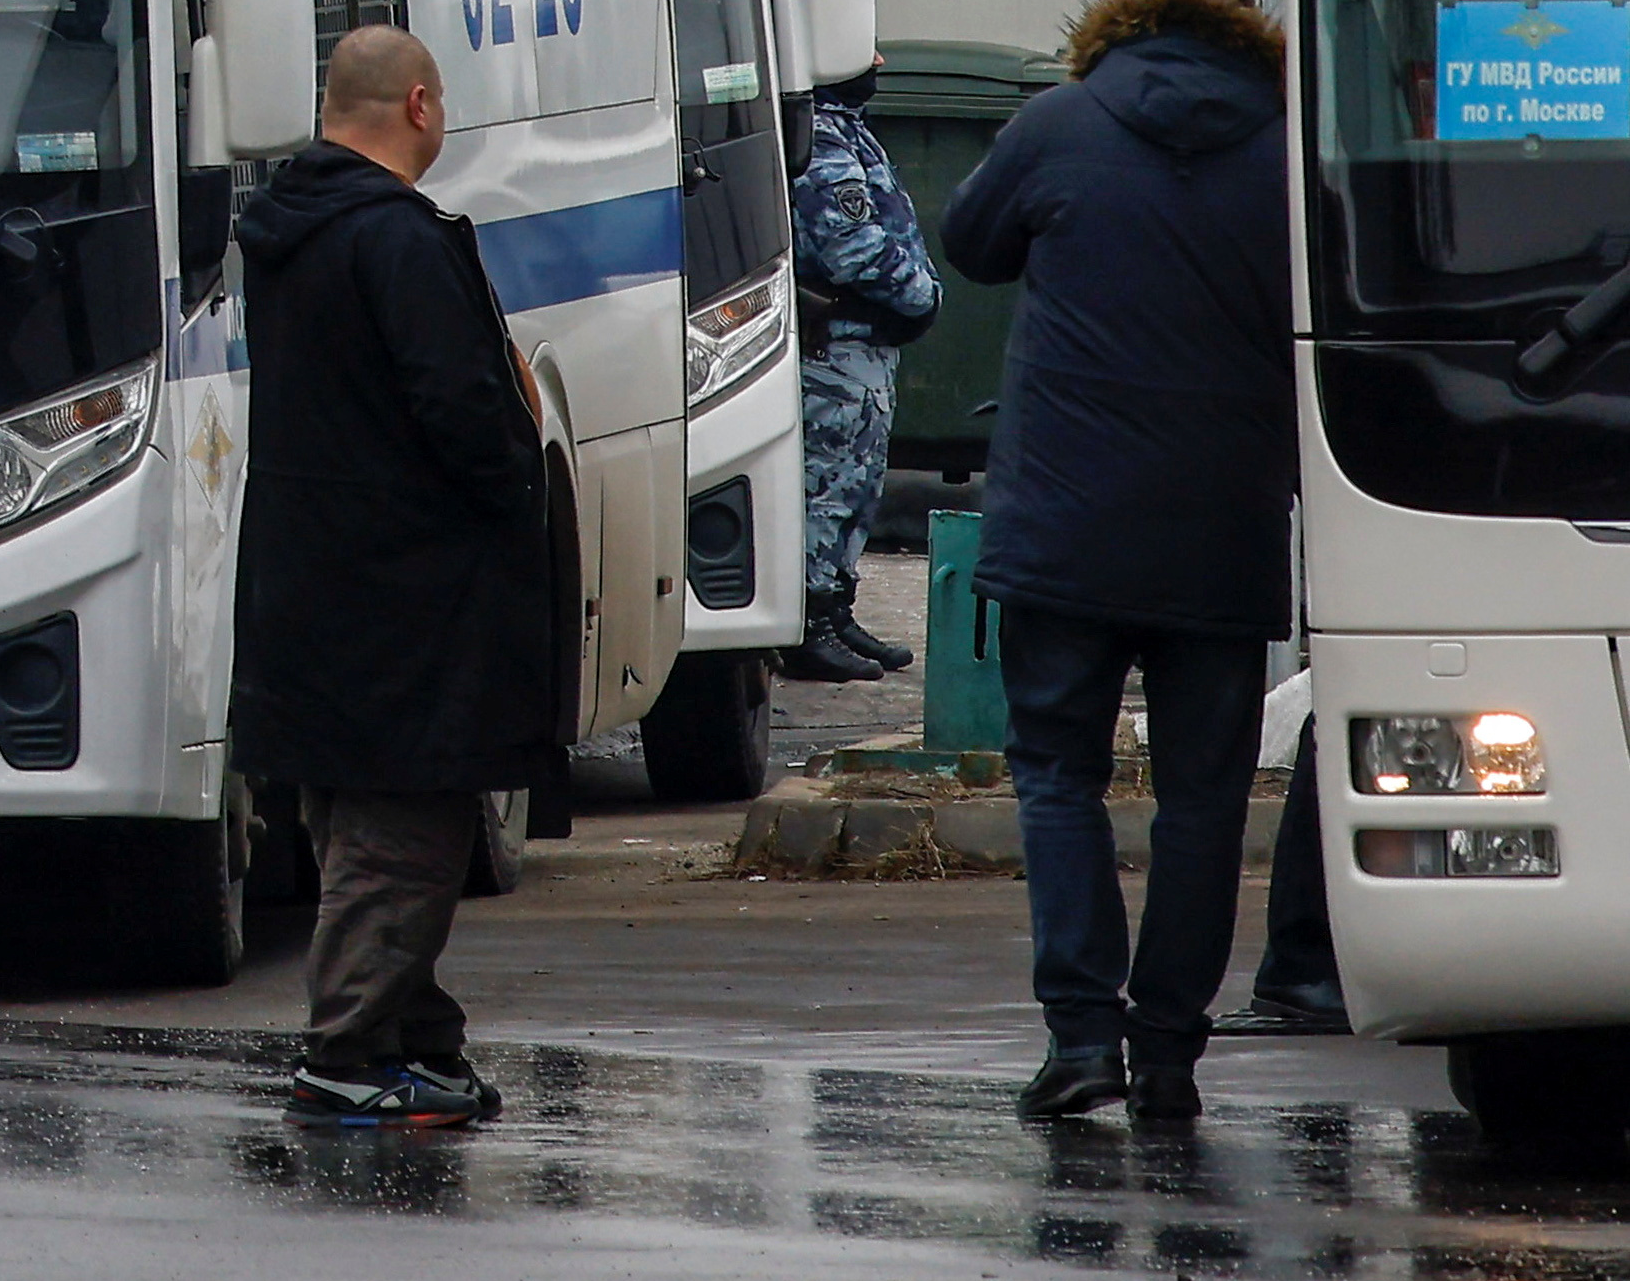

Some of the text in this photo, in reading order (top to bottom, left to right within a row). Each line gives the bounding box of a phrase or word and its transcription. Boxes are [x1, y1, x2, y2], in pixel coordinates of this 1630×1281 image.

[1446, 61, 1621, 90] ГУ МВД России
[1463, 98, 1605, 122] по г. Москве
